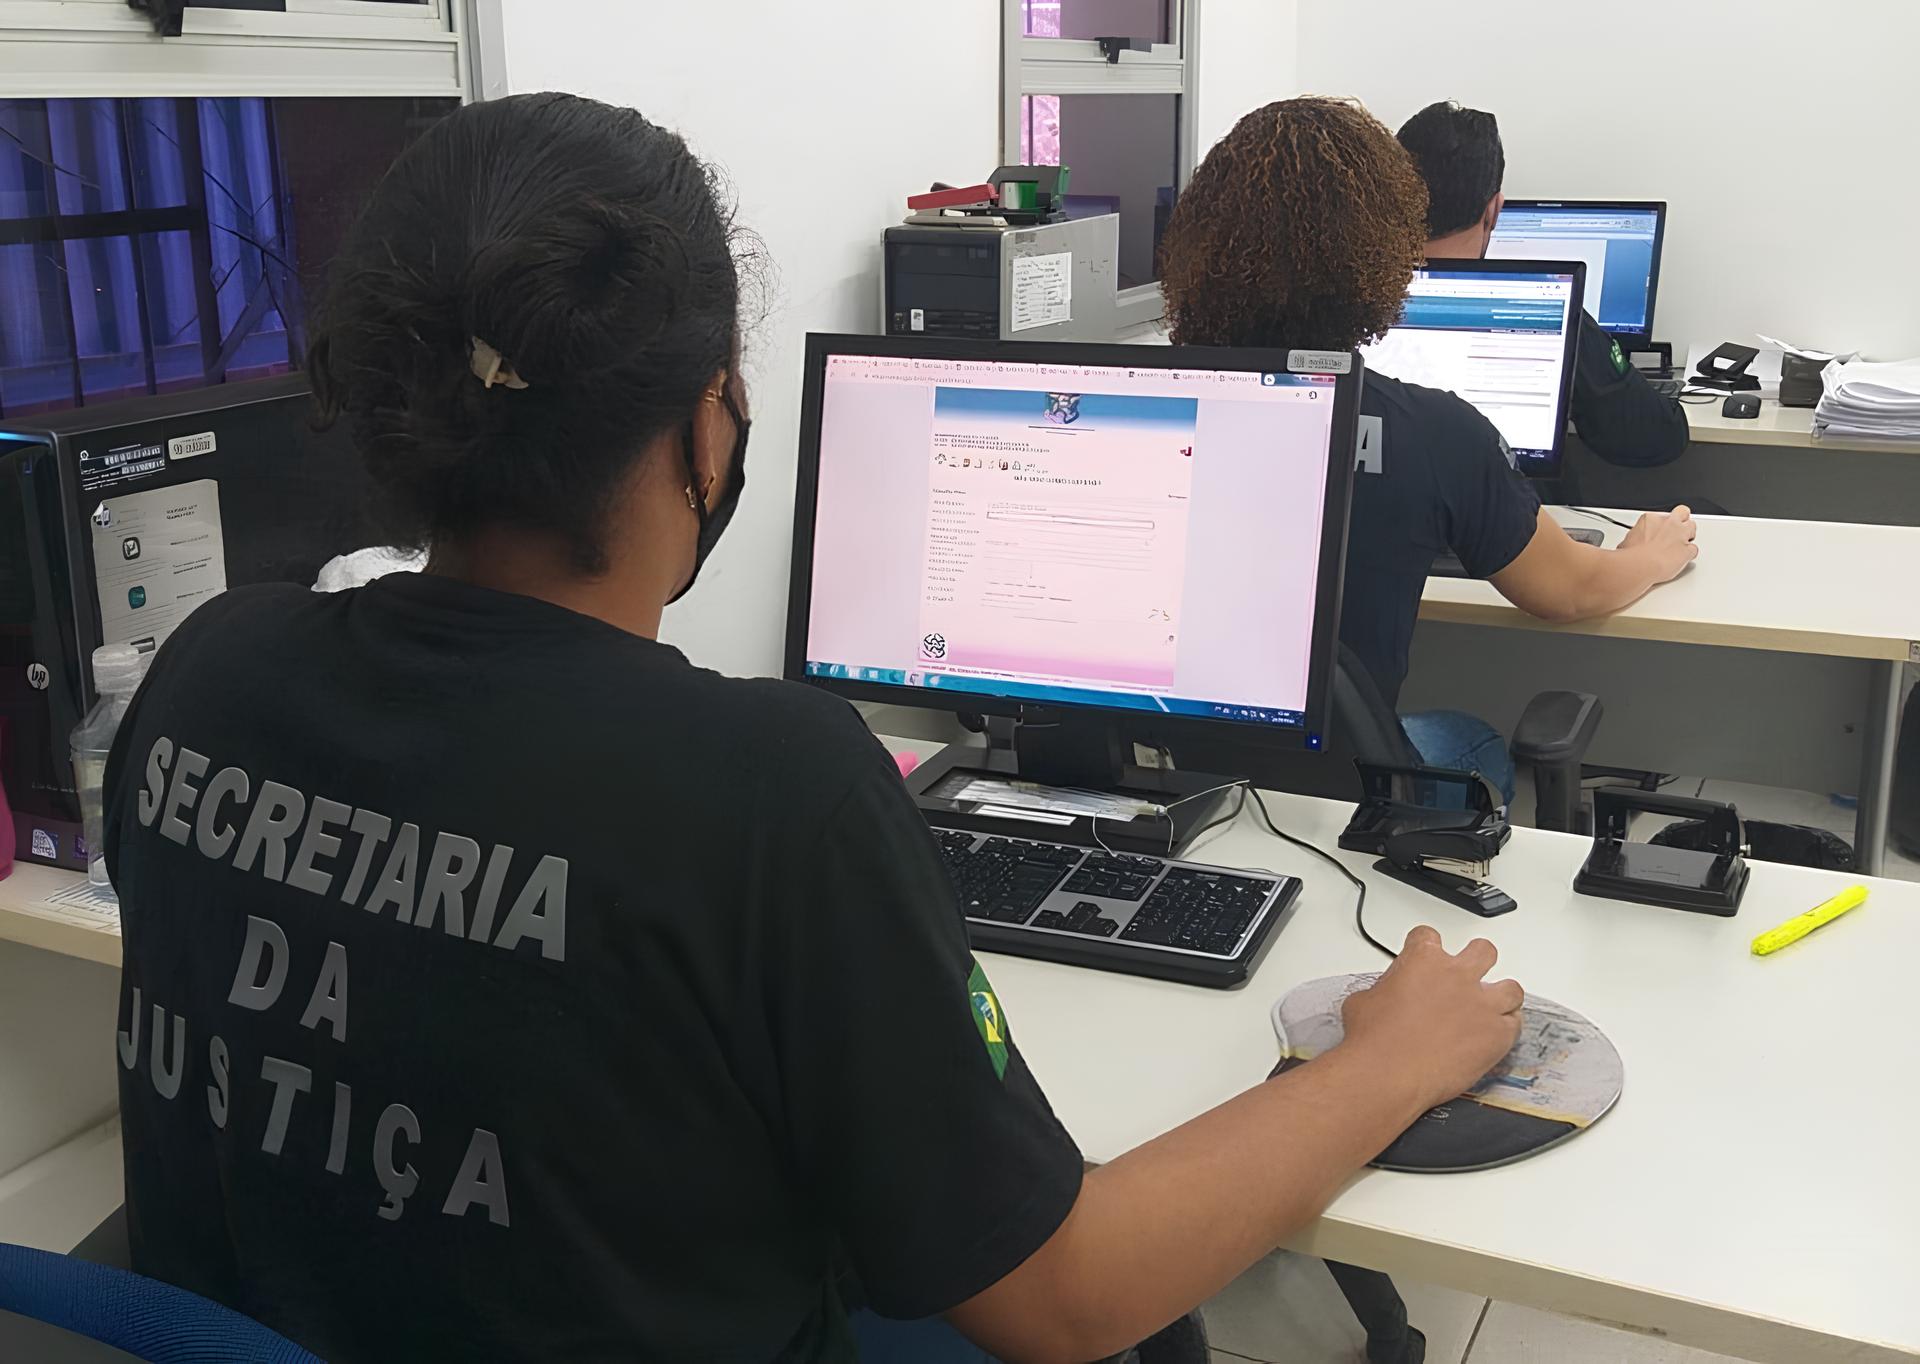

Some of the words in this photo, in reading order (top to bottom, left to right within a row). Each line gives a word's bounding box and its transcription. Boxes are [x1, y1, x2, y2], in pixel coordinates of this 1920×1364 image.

[27, 663, 49, 690] hp
[138, 736, 568, 962] SECRETARIA
[227, 914, 348, 1043] DA
[118, 987, 510, 1227] JUSTIÇA
